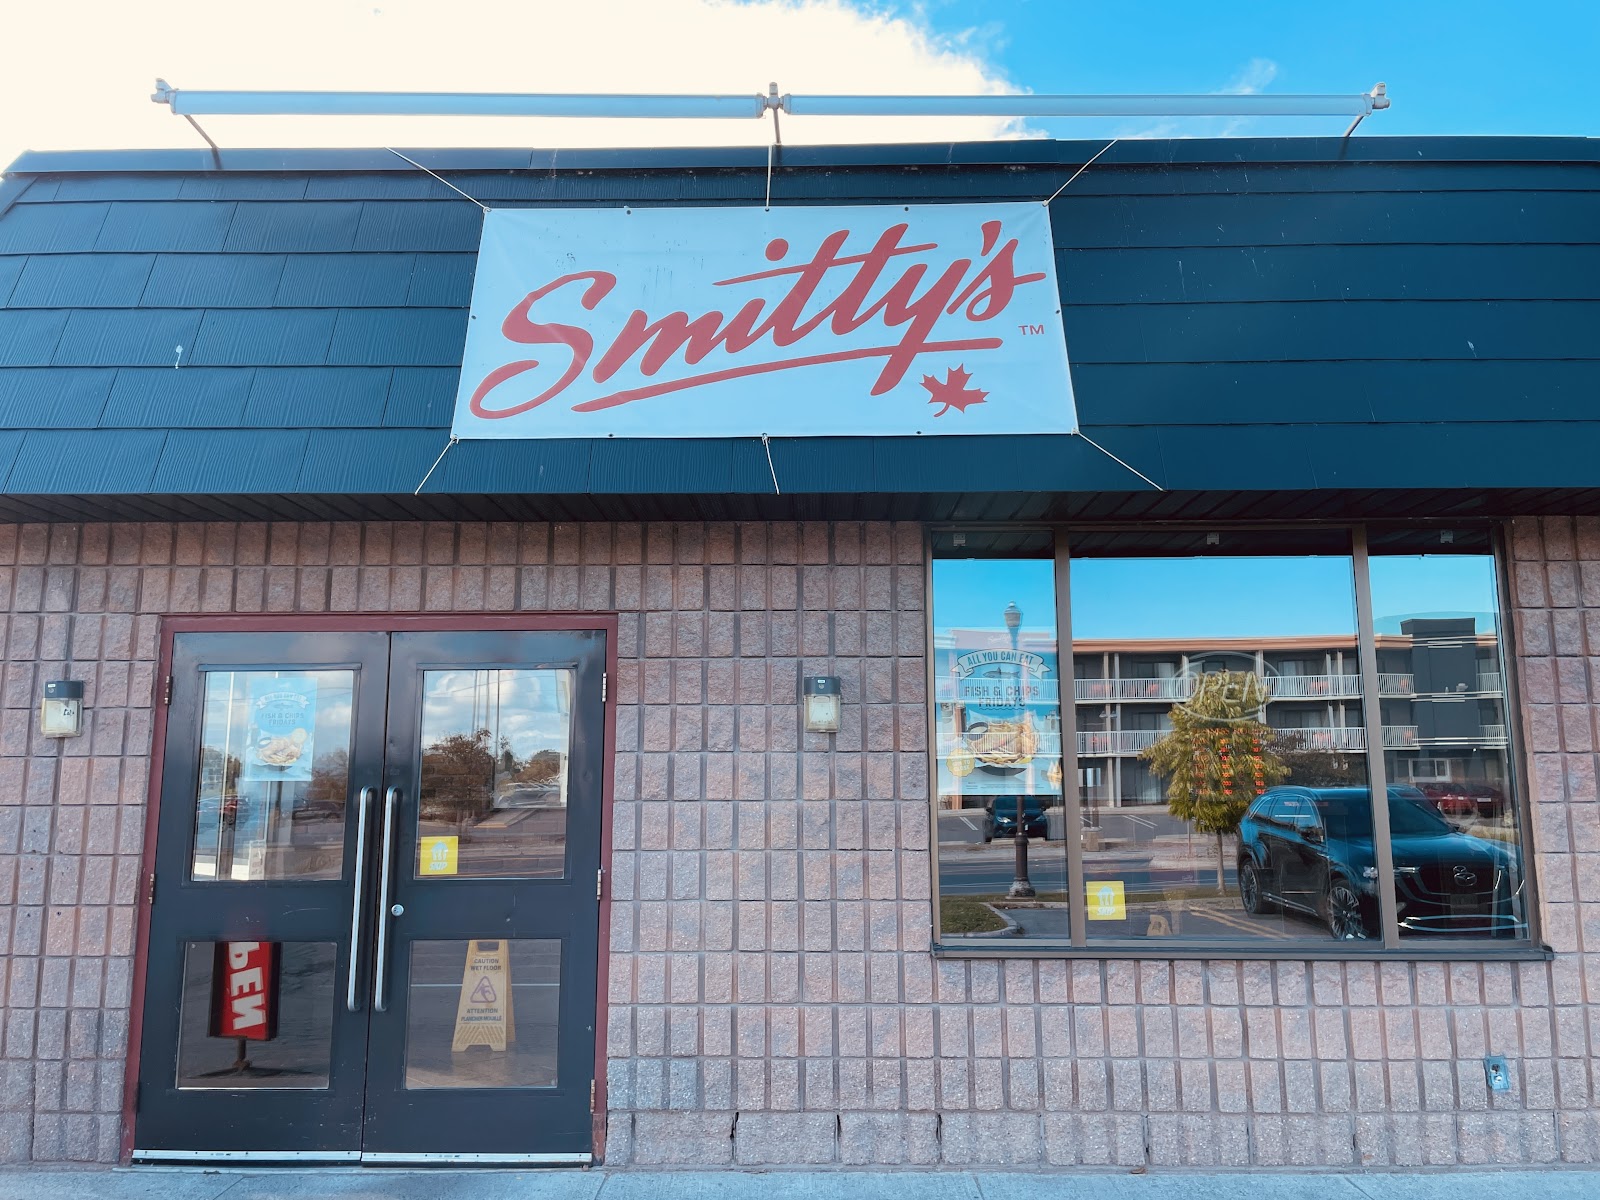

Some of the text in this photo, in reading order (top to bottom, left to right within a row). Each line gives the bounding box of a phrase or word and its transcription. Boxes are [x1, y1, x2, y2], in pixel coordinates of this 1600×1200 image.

[469, 221, 1046, 419] Smitty's
[1018, 325, 1045, 336] TM
[967, 651, 1034, 666] ALL YOU CAN EAT
[964, 686, 1039, 697] FISH & CHIPS
[1176, 668, 1271, 703] OPEN
[978, 697, 1026, 707] FRIDAYS
